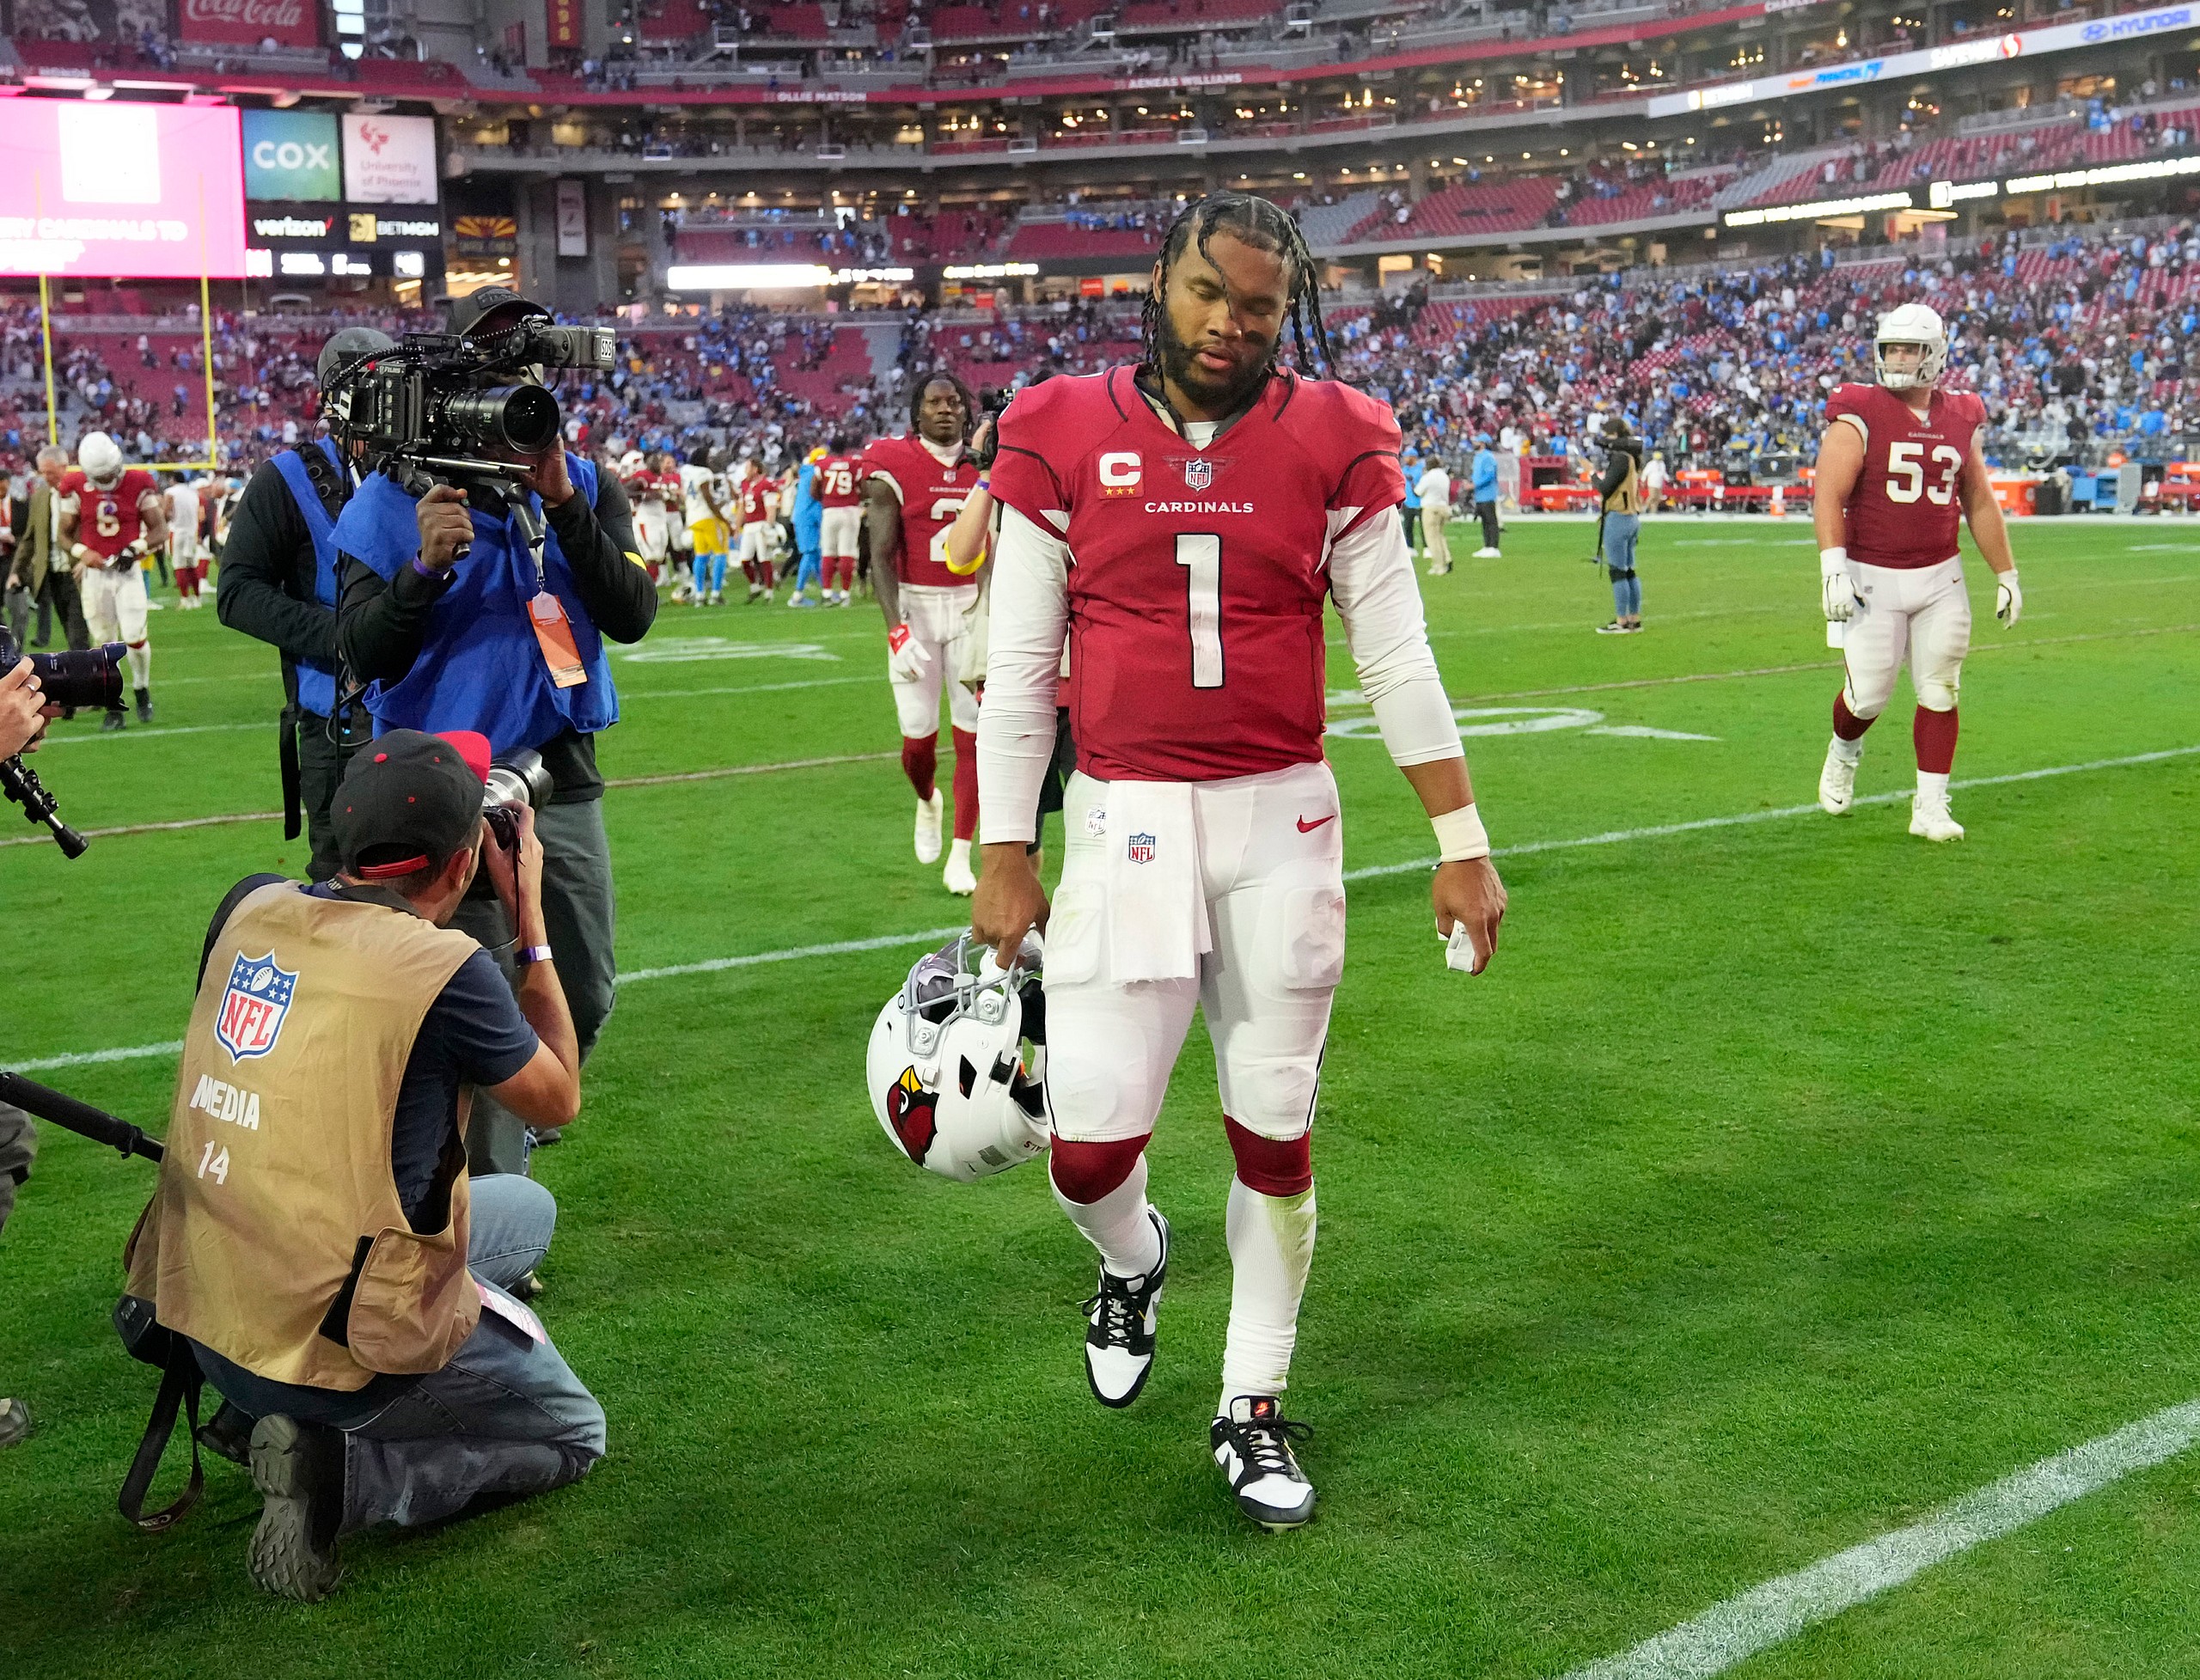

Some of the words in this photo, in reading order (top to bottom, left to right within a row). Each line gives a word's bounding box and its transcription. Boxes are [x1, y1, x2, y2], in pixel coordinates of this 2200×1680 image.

[253, 141, 330, 170] COX
[254, 216, 327, 236] verizon
[823, 469, 852, 496] 79
[1098, 452, 1142, 486] C
[1189, 473, 1207, 486] NFL
[1885, 441, 1962, 505] 53
[96, 500, 120, 537] 6
[1144, 501, 1255, 514] CARDINALS
[1175, 533, 1225, 689] 1
[1131, 846, 1153, 862] NFL
[221, 993, 273, 1048] NFL
[189, 1073, 260, 1131] MEDIA
[197, 1139, 230, 1185] 14
